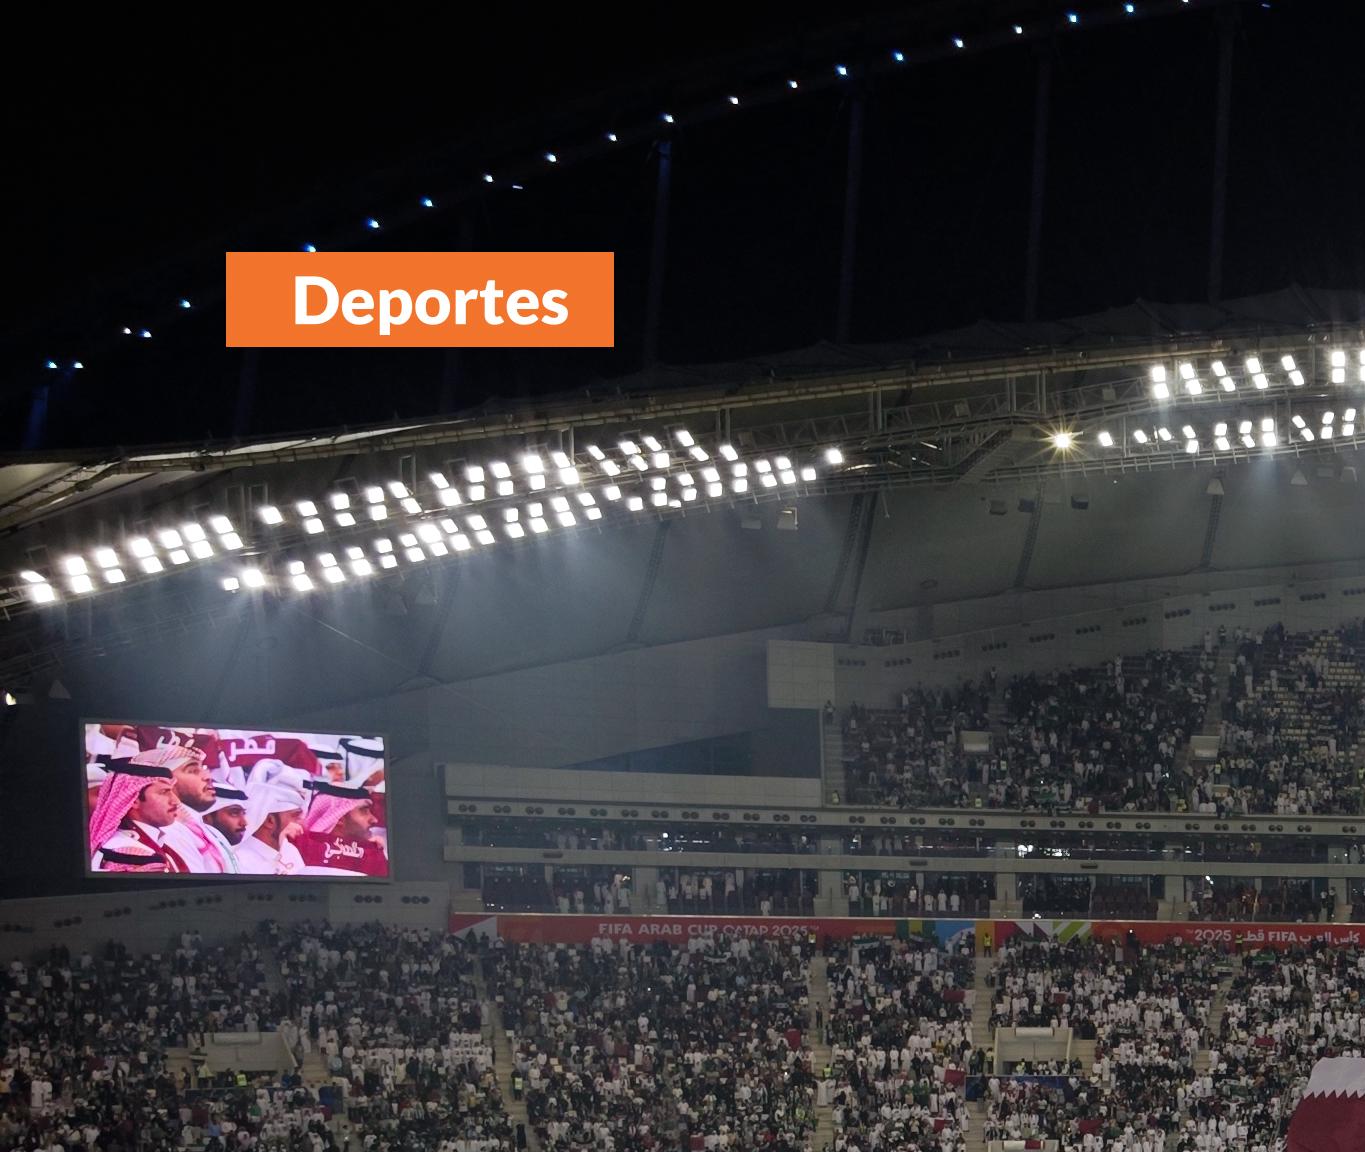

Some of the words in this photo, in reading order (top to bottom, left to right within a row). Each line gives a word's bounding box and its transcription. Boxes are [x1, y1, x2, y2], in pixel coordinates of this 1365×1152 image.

[598, 923, 633, 935] FIFA
[638, 923, 682, 935] ARAB
[1267, 932, 1297, 942] FIFA
